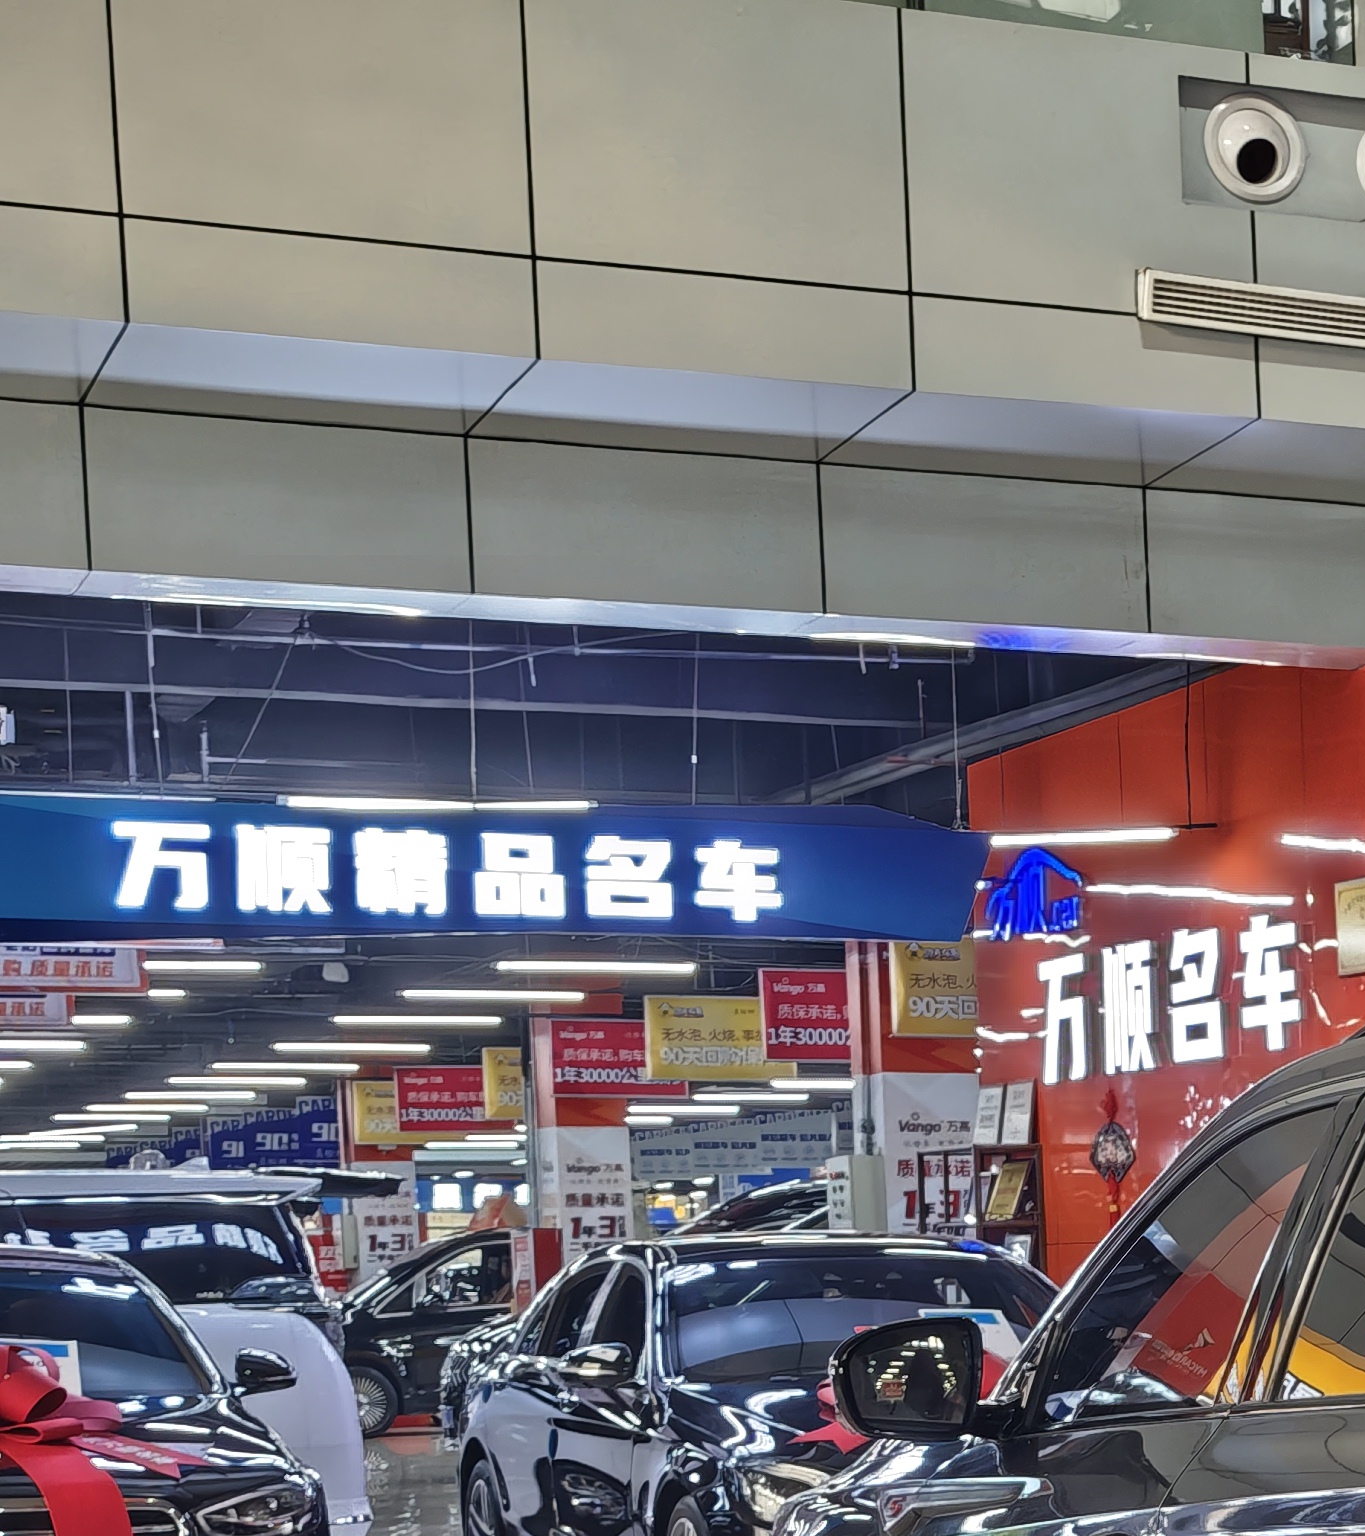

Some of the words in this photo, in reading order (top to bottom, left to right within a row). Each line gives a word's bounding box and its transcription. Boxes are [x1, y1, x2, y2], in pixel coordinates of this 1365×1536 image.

[112, 820, 784, 923] 万顺精品名车
[1037, 914, 1302, 1086] 万顺名车
[897, 1119, 942, 1136] Vango
